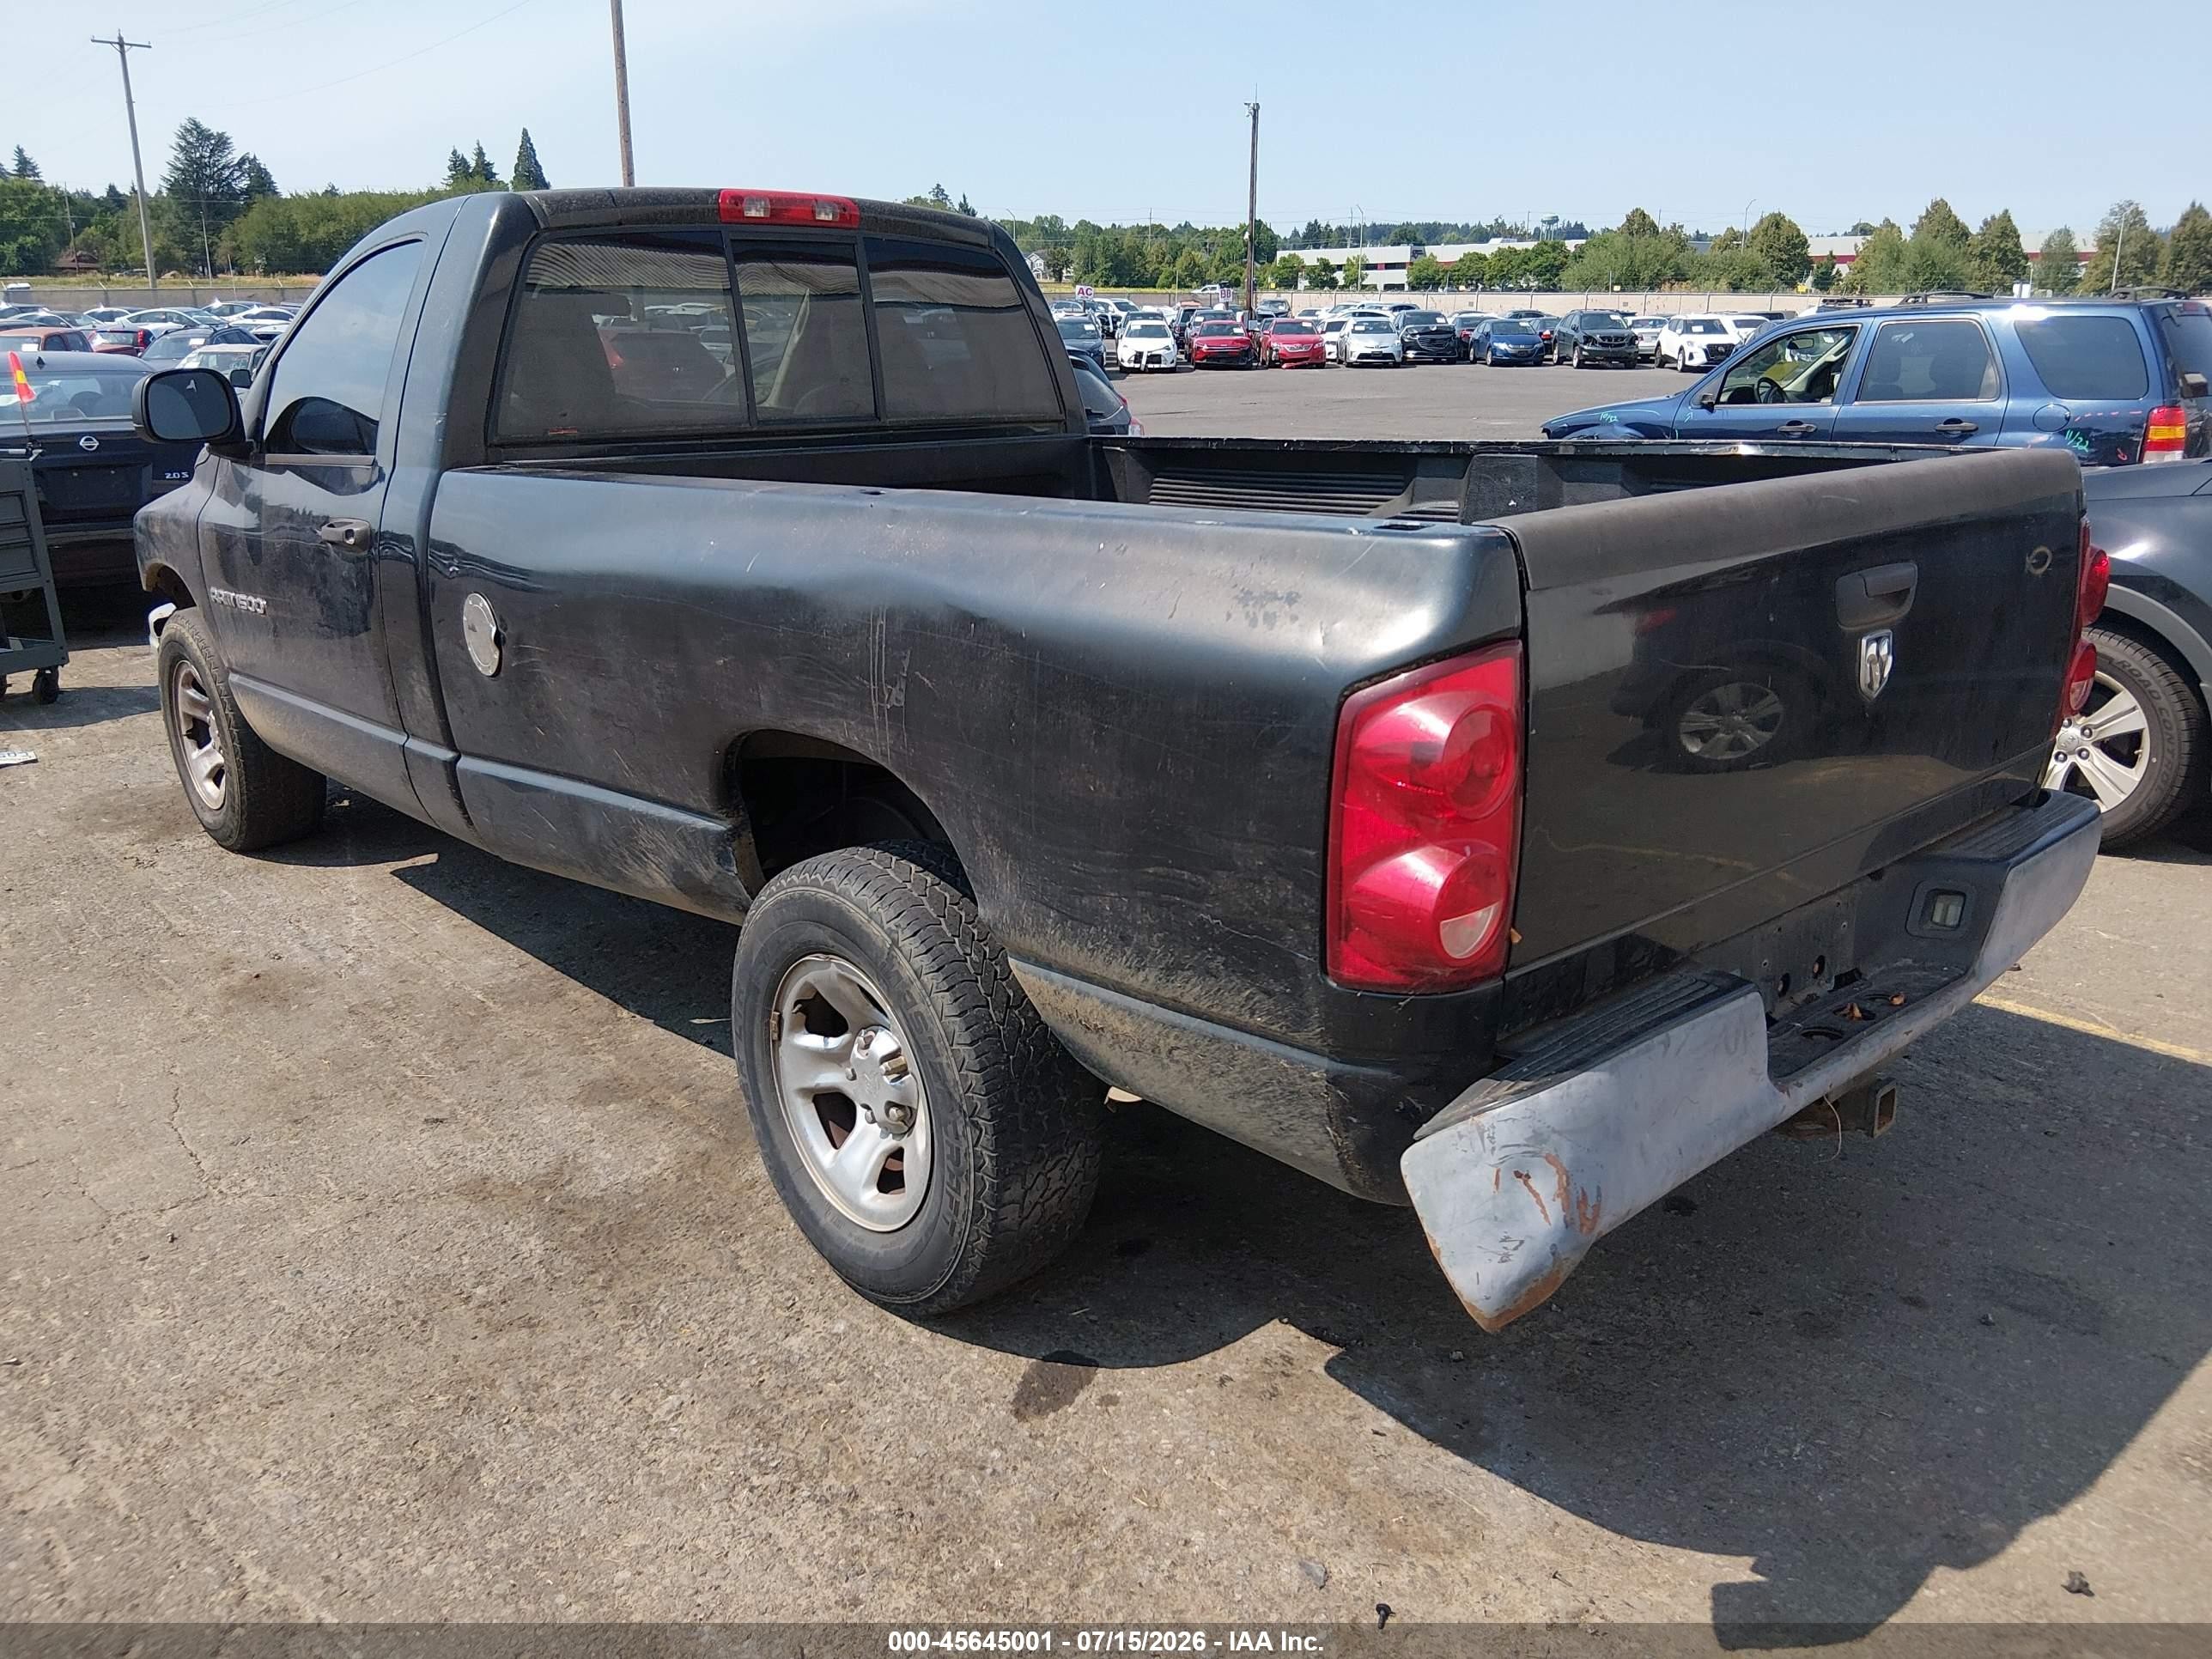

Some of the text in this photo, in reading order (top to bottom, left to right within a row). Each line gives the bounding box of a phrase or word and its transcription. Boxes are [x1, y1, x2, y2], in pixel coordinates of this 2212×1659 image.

[1077, 288, 1093, 296] AC
[2065, 429, 2089, 453] 11/32
[235, 593, 266, 615] 1500
[2117, 660, 2161, 700] ROAD
